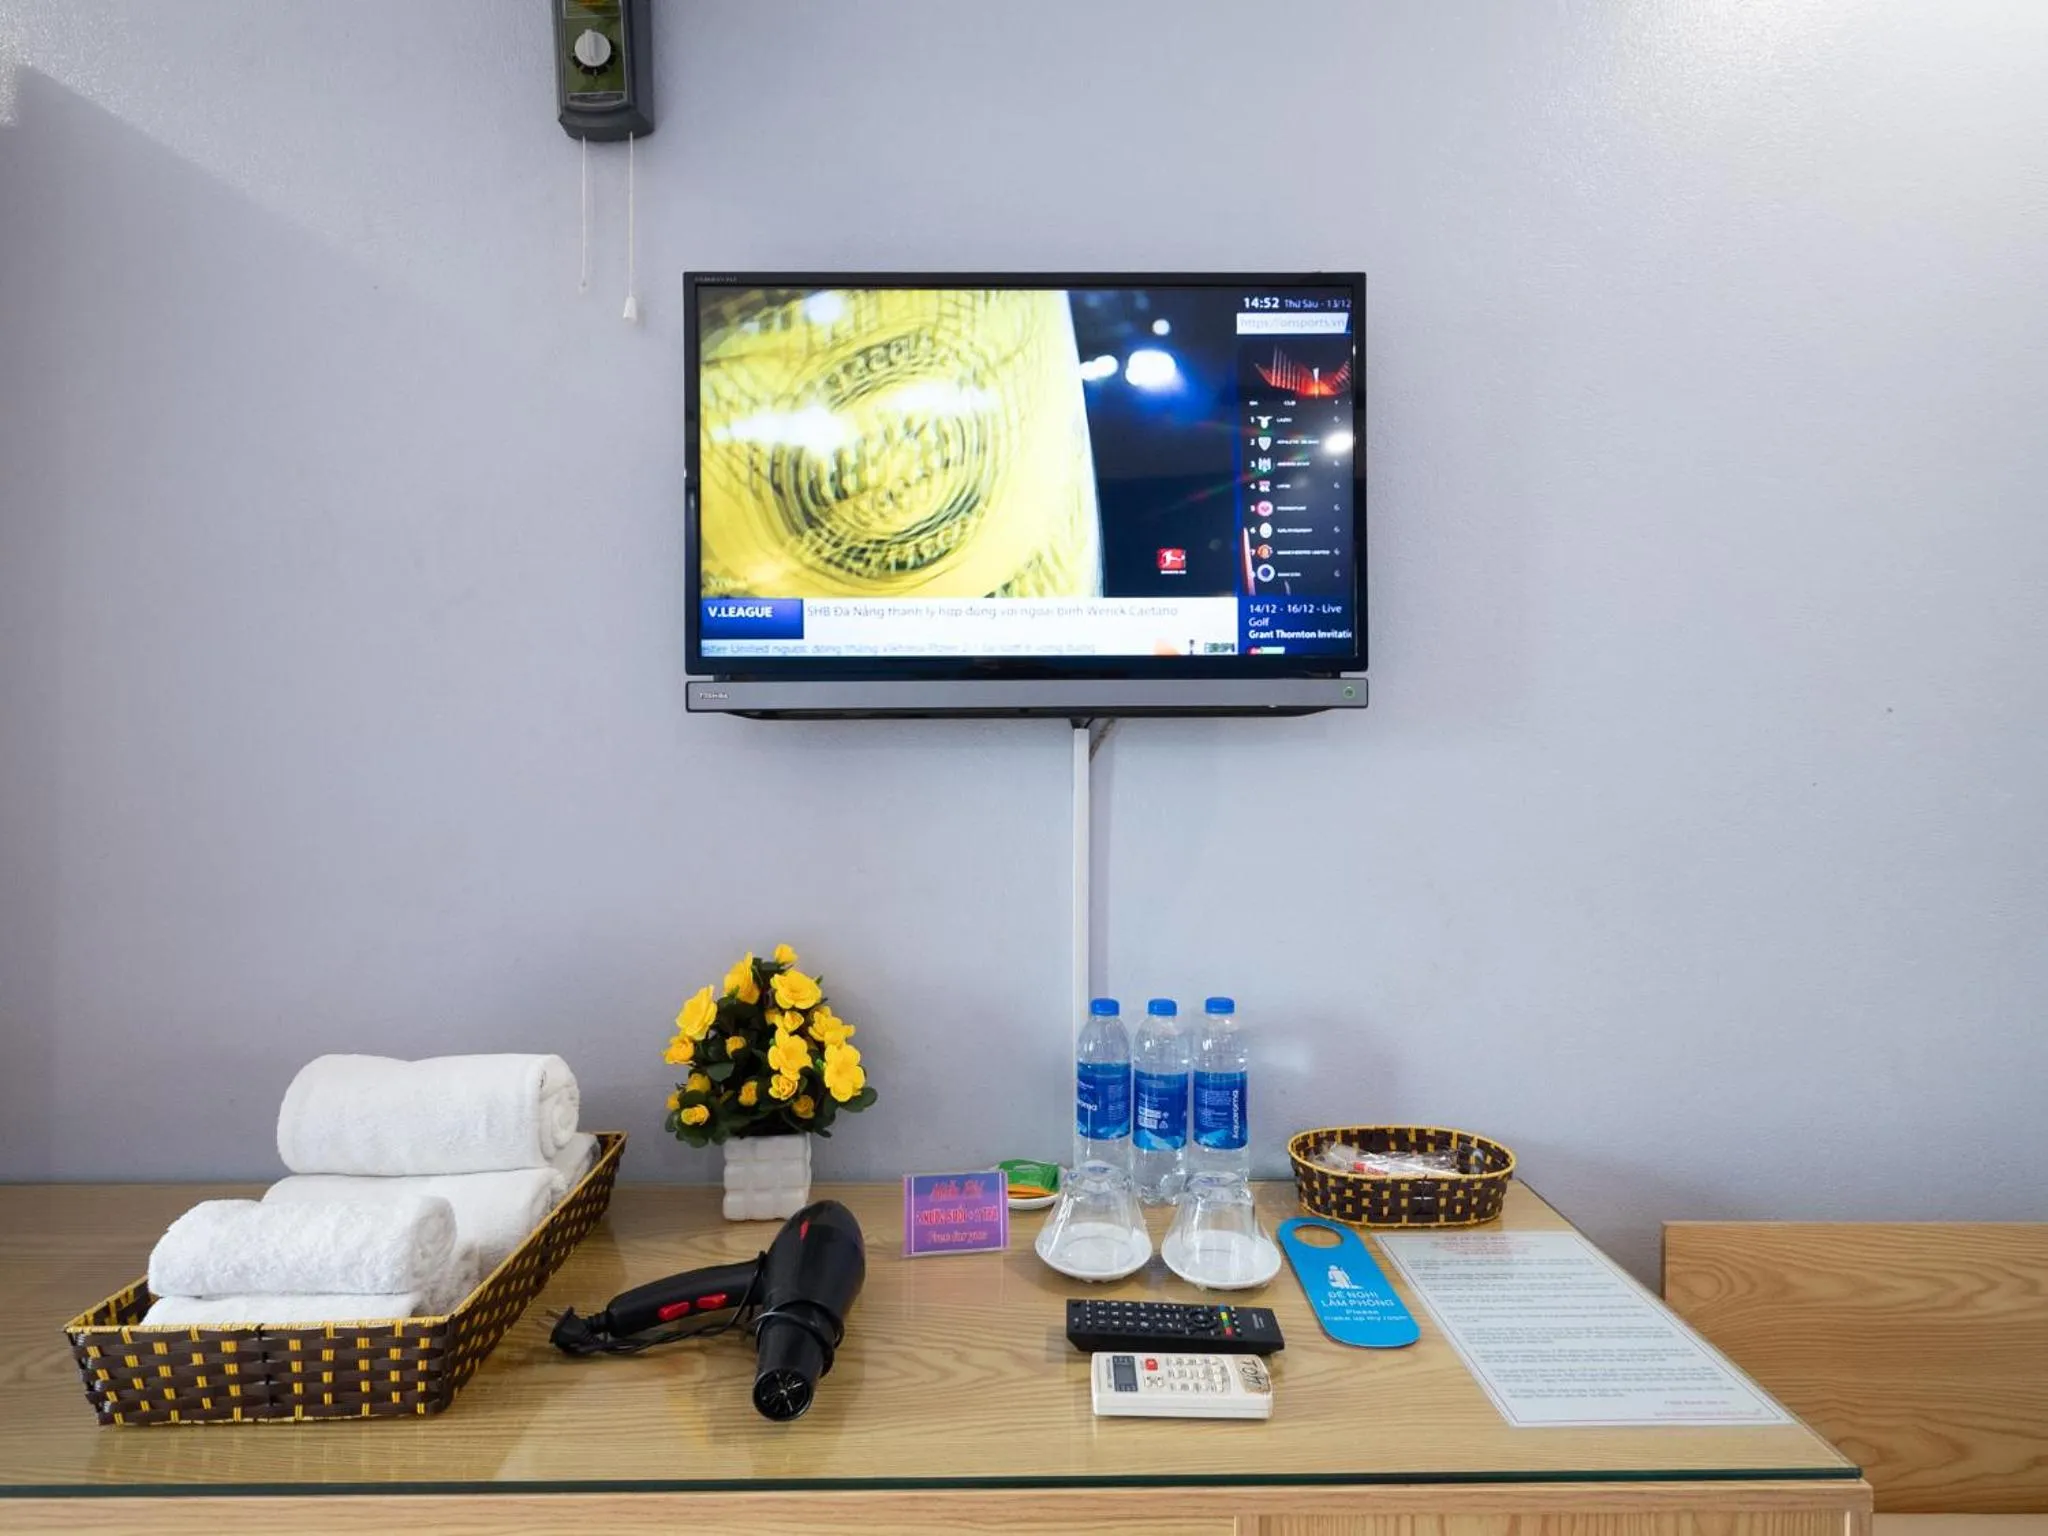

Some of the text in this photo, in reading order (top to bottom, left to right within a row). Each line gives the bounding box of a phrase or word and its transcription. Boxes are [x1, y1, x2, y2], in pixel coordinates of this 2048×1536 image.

[1243, 297, 1280, 309] 14:52
[707, 606, 773, 618] V.LEAGUE
[807, 606, 830, 617] SHB
[1249, 604, 1277, 614] 14/12
[1287, 604, 1315, 614] 16/12
[1322, 603, 1342, 614] Live
[1248, 617, 1270, 627] Golf
[1248, 630, 1274, 639] Grant
[1275, 629, 1317, 639] Thornton
